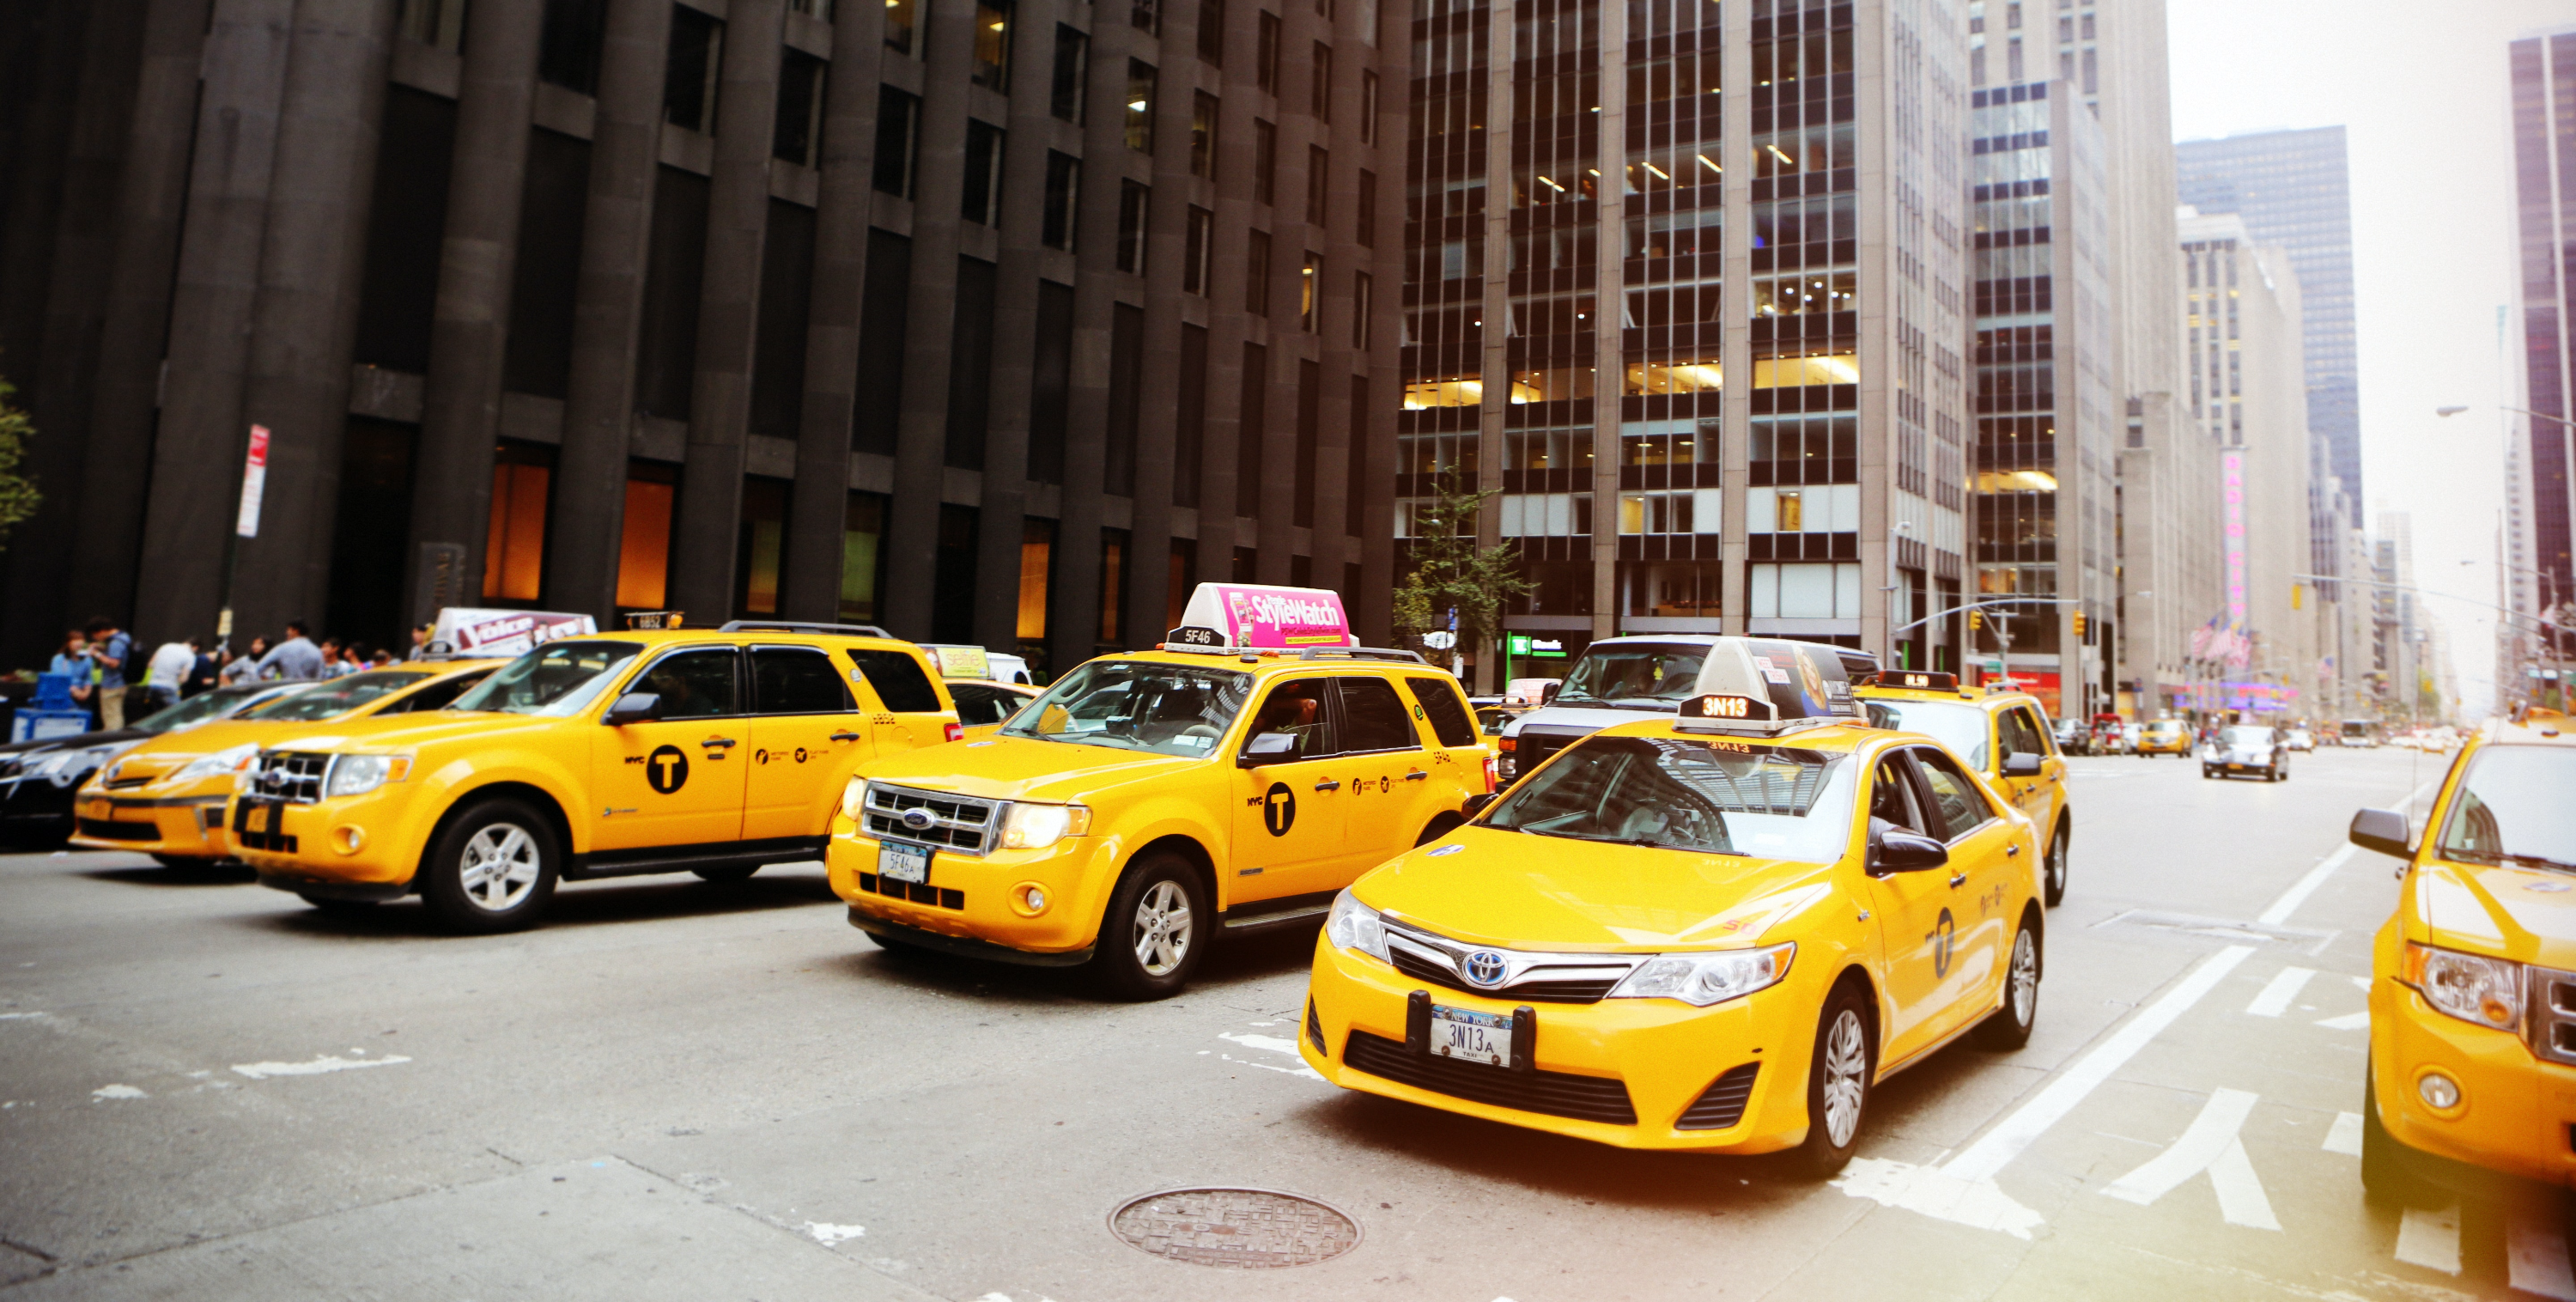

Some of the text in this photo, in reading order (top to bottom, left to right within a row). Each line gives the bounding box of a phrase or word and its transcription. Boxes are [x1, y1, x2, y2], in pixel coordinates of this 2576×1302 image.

[2226, 456, 2246, 617] RADIO CITY
[1252, 595, 1340, 631] StyleWatch
[1185, 630, 1211, 643] 5F46
[1703, 697, 1747, 716] 3N13
[625, 756, 645, 764] NYC
[1247, 796, 1263, 806] NYC
[1451, 1013, 1495, 1027] NEW YORK
[1449, 1024, 1495, 1054] 3N13A
